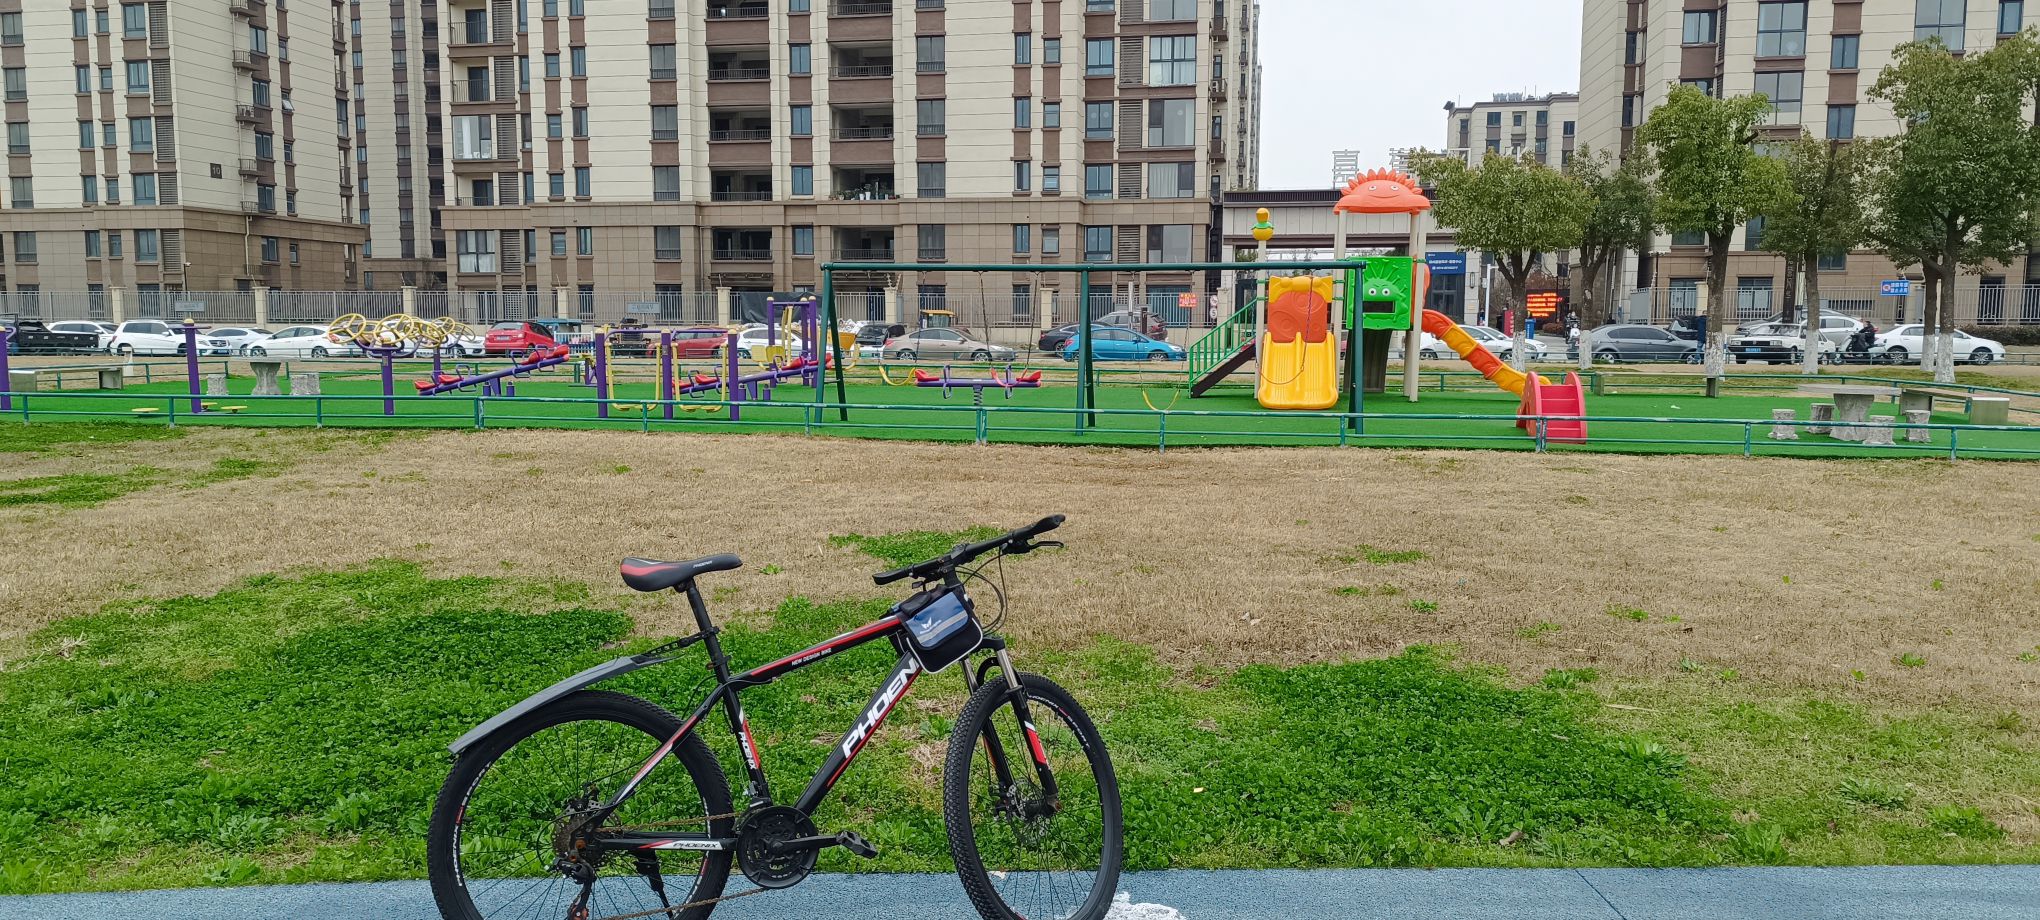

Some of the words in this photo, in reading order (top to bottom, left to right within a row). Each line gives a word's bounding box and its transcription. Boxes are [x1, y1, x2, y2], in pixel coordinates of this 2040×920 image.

[212, 166, 221, 175] 10
[791, 657, 802, 666] NEW
[803, 652, 820, 662] DESIGN
[821, 647, 832, 656] BIKE
[1067, 715, 1091, 748] SPORT
[738, 731, 757, 770] PHOENIX
[452, 825, 463, 887] PHOENIX
[461, 761, 492, 806] SPORT
